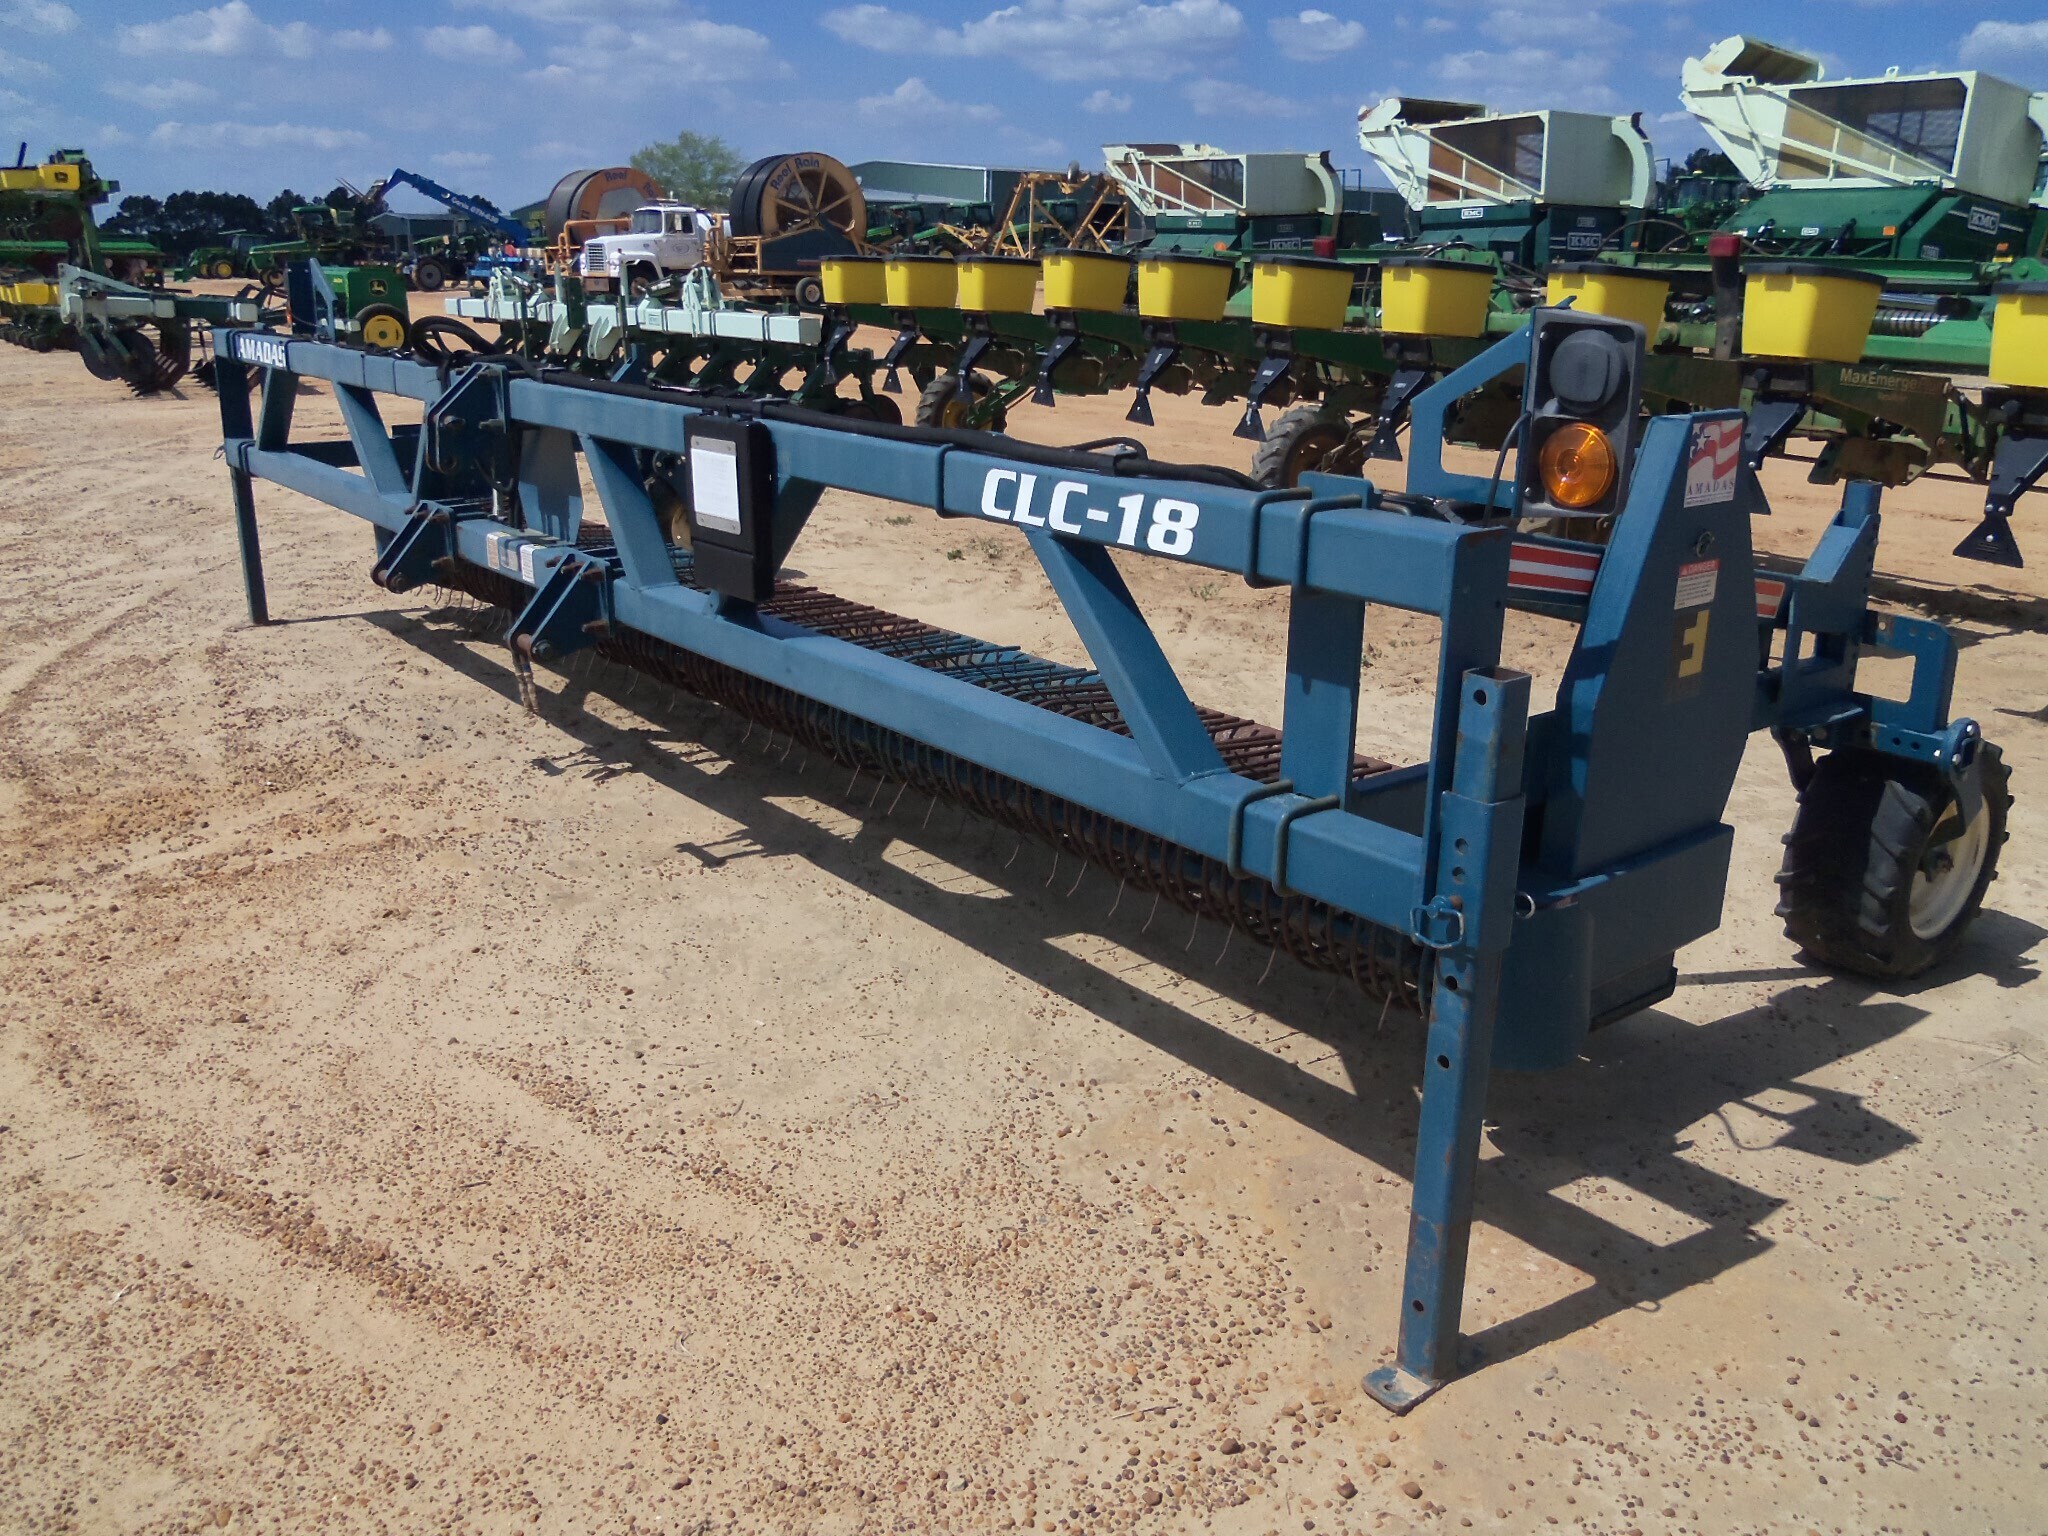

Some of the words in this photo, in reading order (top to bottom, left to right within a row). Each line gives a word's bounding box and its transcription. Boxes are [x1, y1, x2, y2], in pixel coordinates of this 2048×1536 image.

[770, 163, 792, 190] Reel
[795, 156, 820, 169] Rain
[1970, 213, 1998, 230] KMC
[1272, 240, 1300, 250] KMC
[1569, 236, 1600, 248] KMC
[238, 336, 287, 368] AMADAS
[1840, 367, 1918, 391] MaxEmerge
[1688, 481, 1737, 495] AMADAS
[981, 468, 1200, 556] CLC-18
